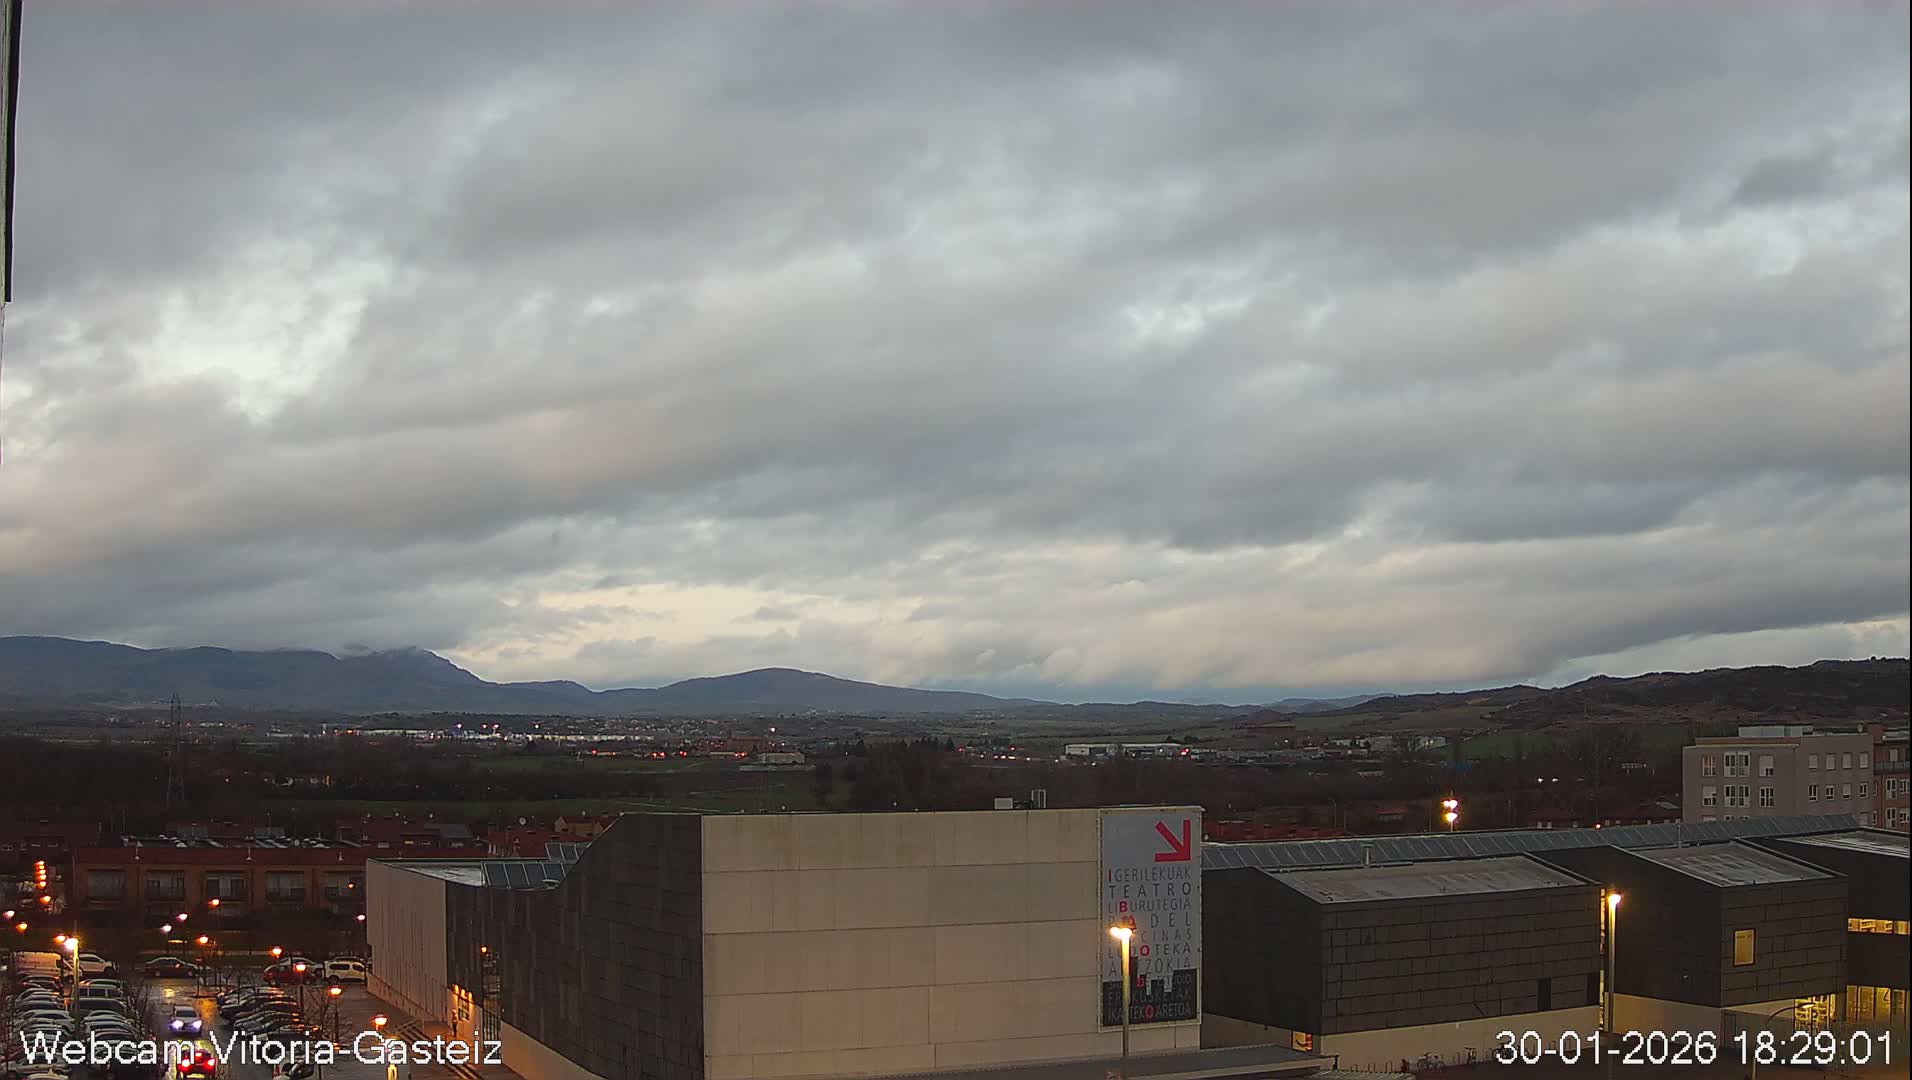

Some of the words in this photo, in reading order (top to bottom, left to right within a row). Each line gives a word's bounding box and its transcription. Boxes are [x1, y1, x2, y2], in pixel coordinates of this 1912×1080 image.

[1108, 866, 1191, 882] IGERILEKUAK
[1108, 882, 1191, 898] TEATRO
[1108, 899, 1191, 913] LIBURUTEGIA
[1110, 957, 1191, 976] AZOKIA
